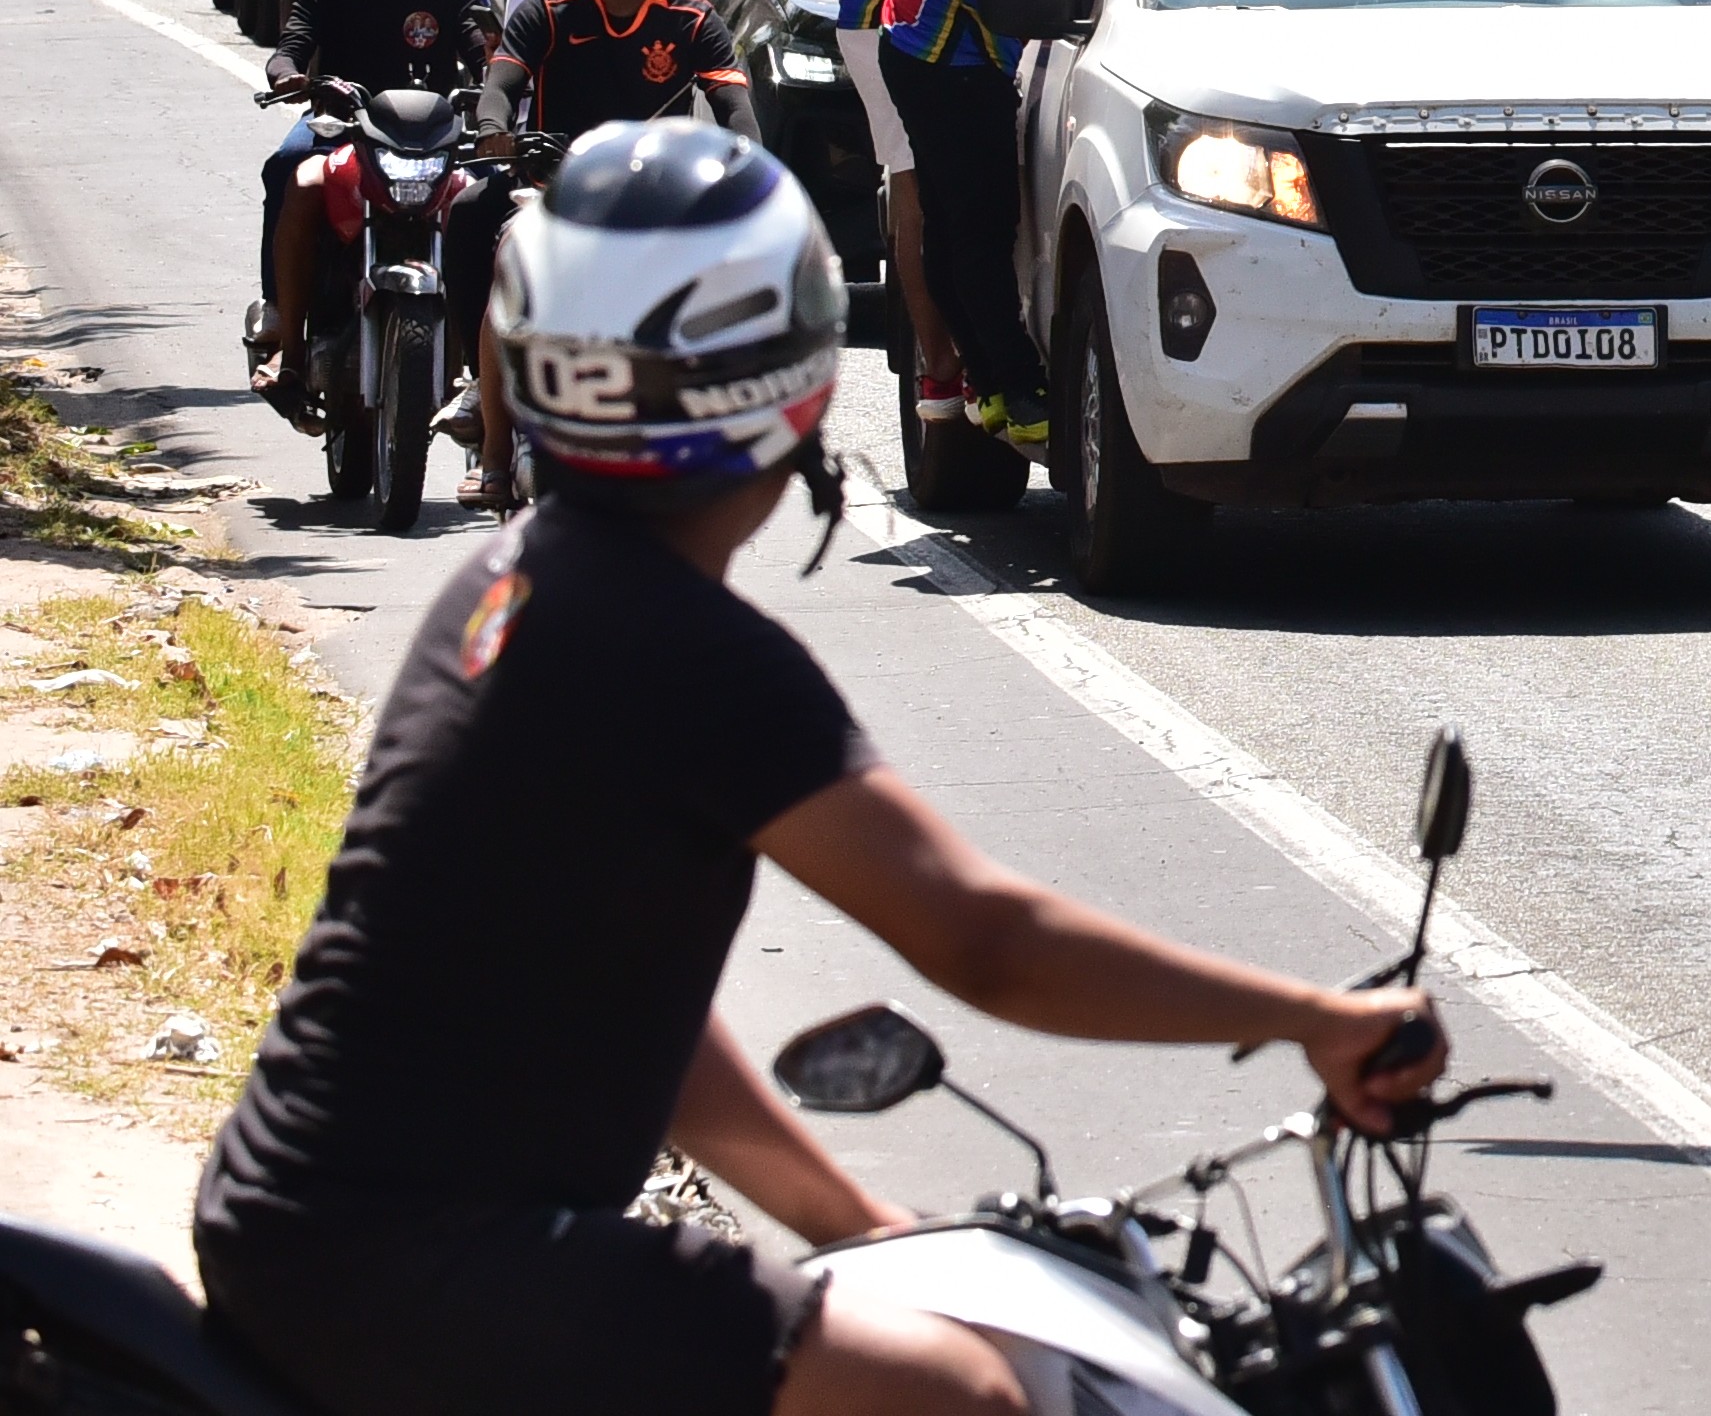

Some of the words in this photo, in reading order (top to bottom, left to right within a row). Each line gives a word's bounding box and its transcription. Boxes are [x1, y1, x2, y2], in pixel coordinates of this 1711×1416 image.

[1525, 189, 1597, 200] NISSAN
[1548, 316, 1579, 326] BRASIL
[528, 344, 638, 421] 02
